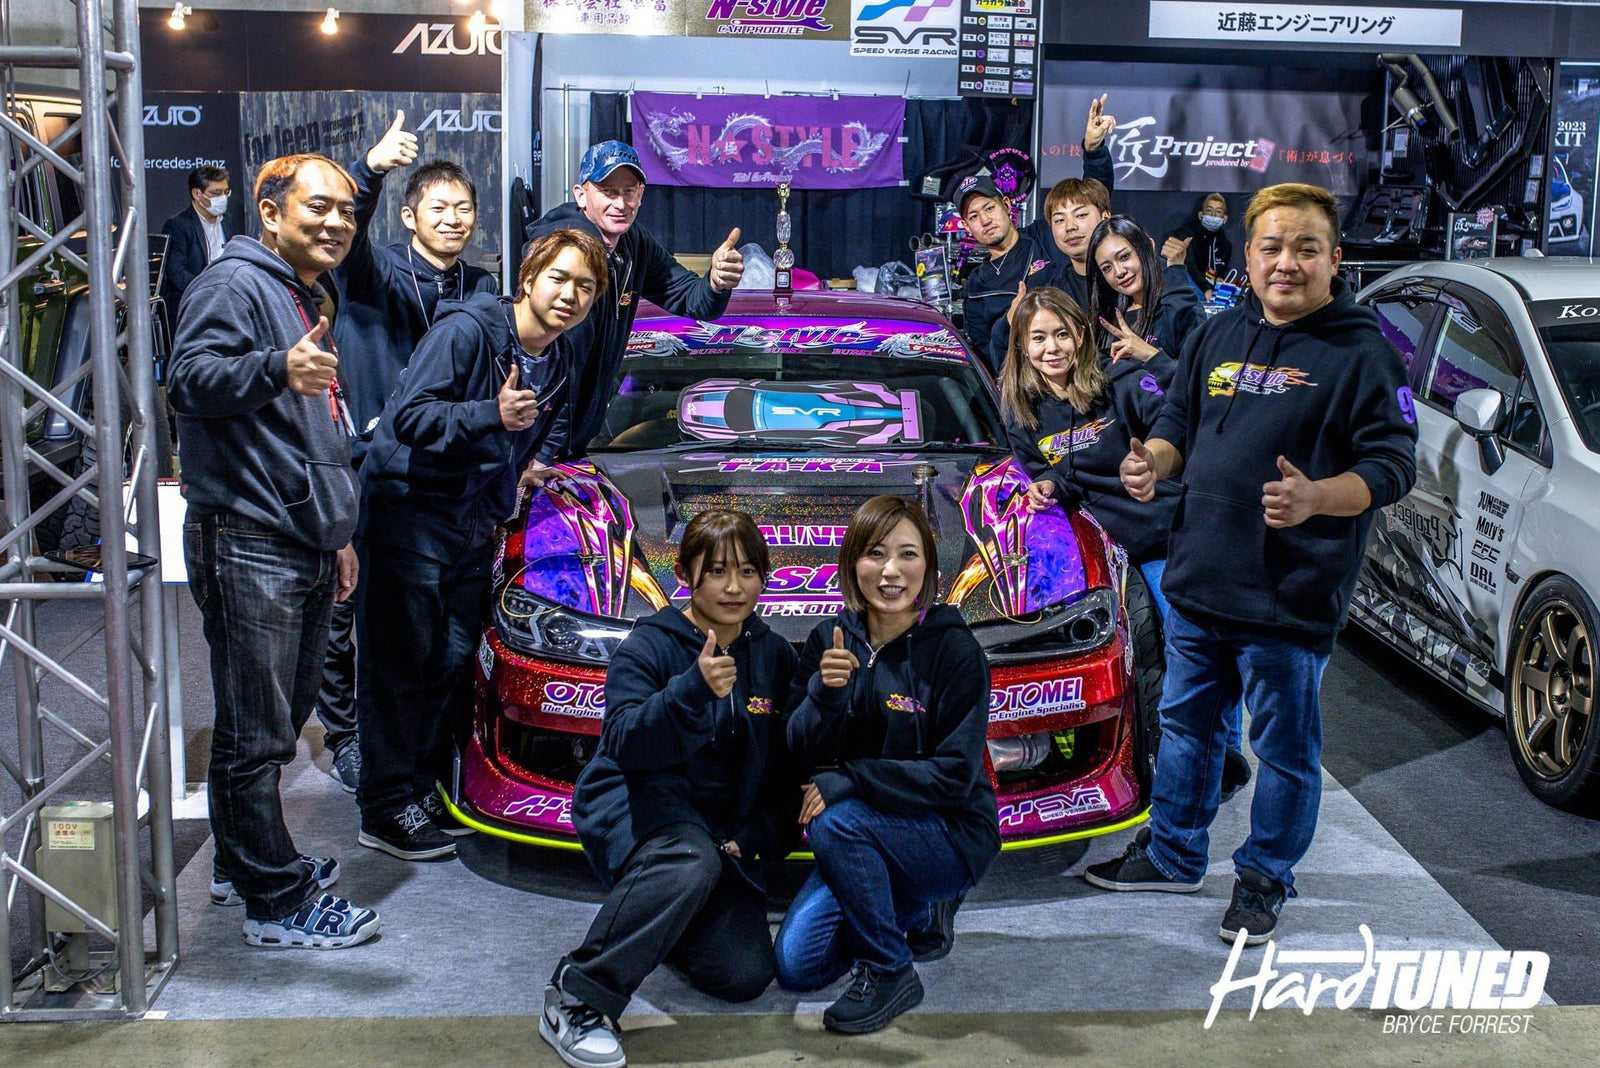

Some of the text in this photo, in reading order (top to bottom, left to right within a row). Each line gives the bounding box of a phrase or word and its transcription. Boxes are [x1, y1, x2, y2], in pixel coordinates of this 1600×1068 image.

[717, 25, 804, 35] CAR PRODUCE
[1217, 11, 1395, 35] 近藤エンジニアリング
[854, 26, 957, 46] SVR
[142, 105, 201, 126] ZUTO
[1557, 121, 1586, 131] 2023
[1150, 136, 1258, 166] Project
[144, 156, 226, 169] ercedes-Benz
[1205, 159, 1250, 168] produced by
[1556, 305, 1600, 319] Ko
[924, 346, 963, 357] VALINO
[771, 406, 841, 417] SVR
[1396, 386, 1416, 424] 9
[1477, 490, 1495, 513] JUN
[1475, 515, 1505, 542] Moty's
[1472, 539, 1501, 562] PFC
[1470, 561, 1497, 588] DRL
[542, 702, 602, 718] The Engine
[998, 708, 1036, 720] Engine
[1036, 700, 1086, 715] Specialist
[1065, 806, 1087, 815] VERSE
